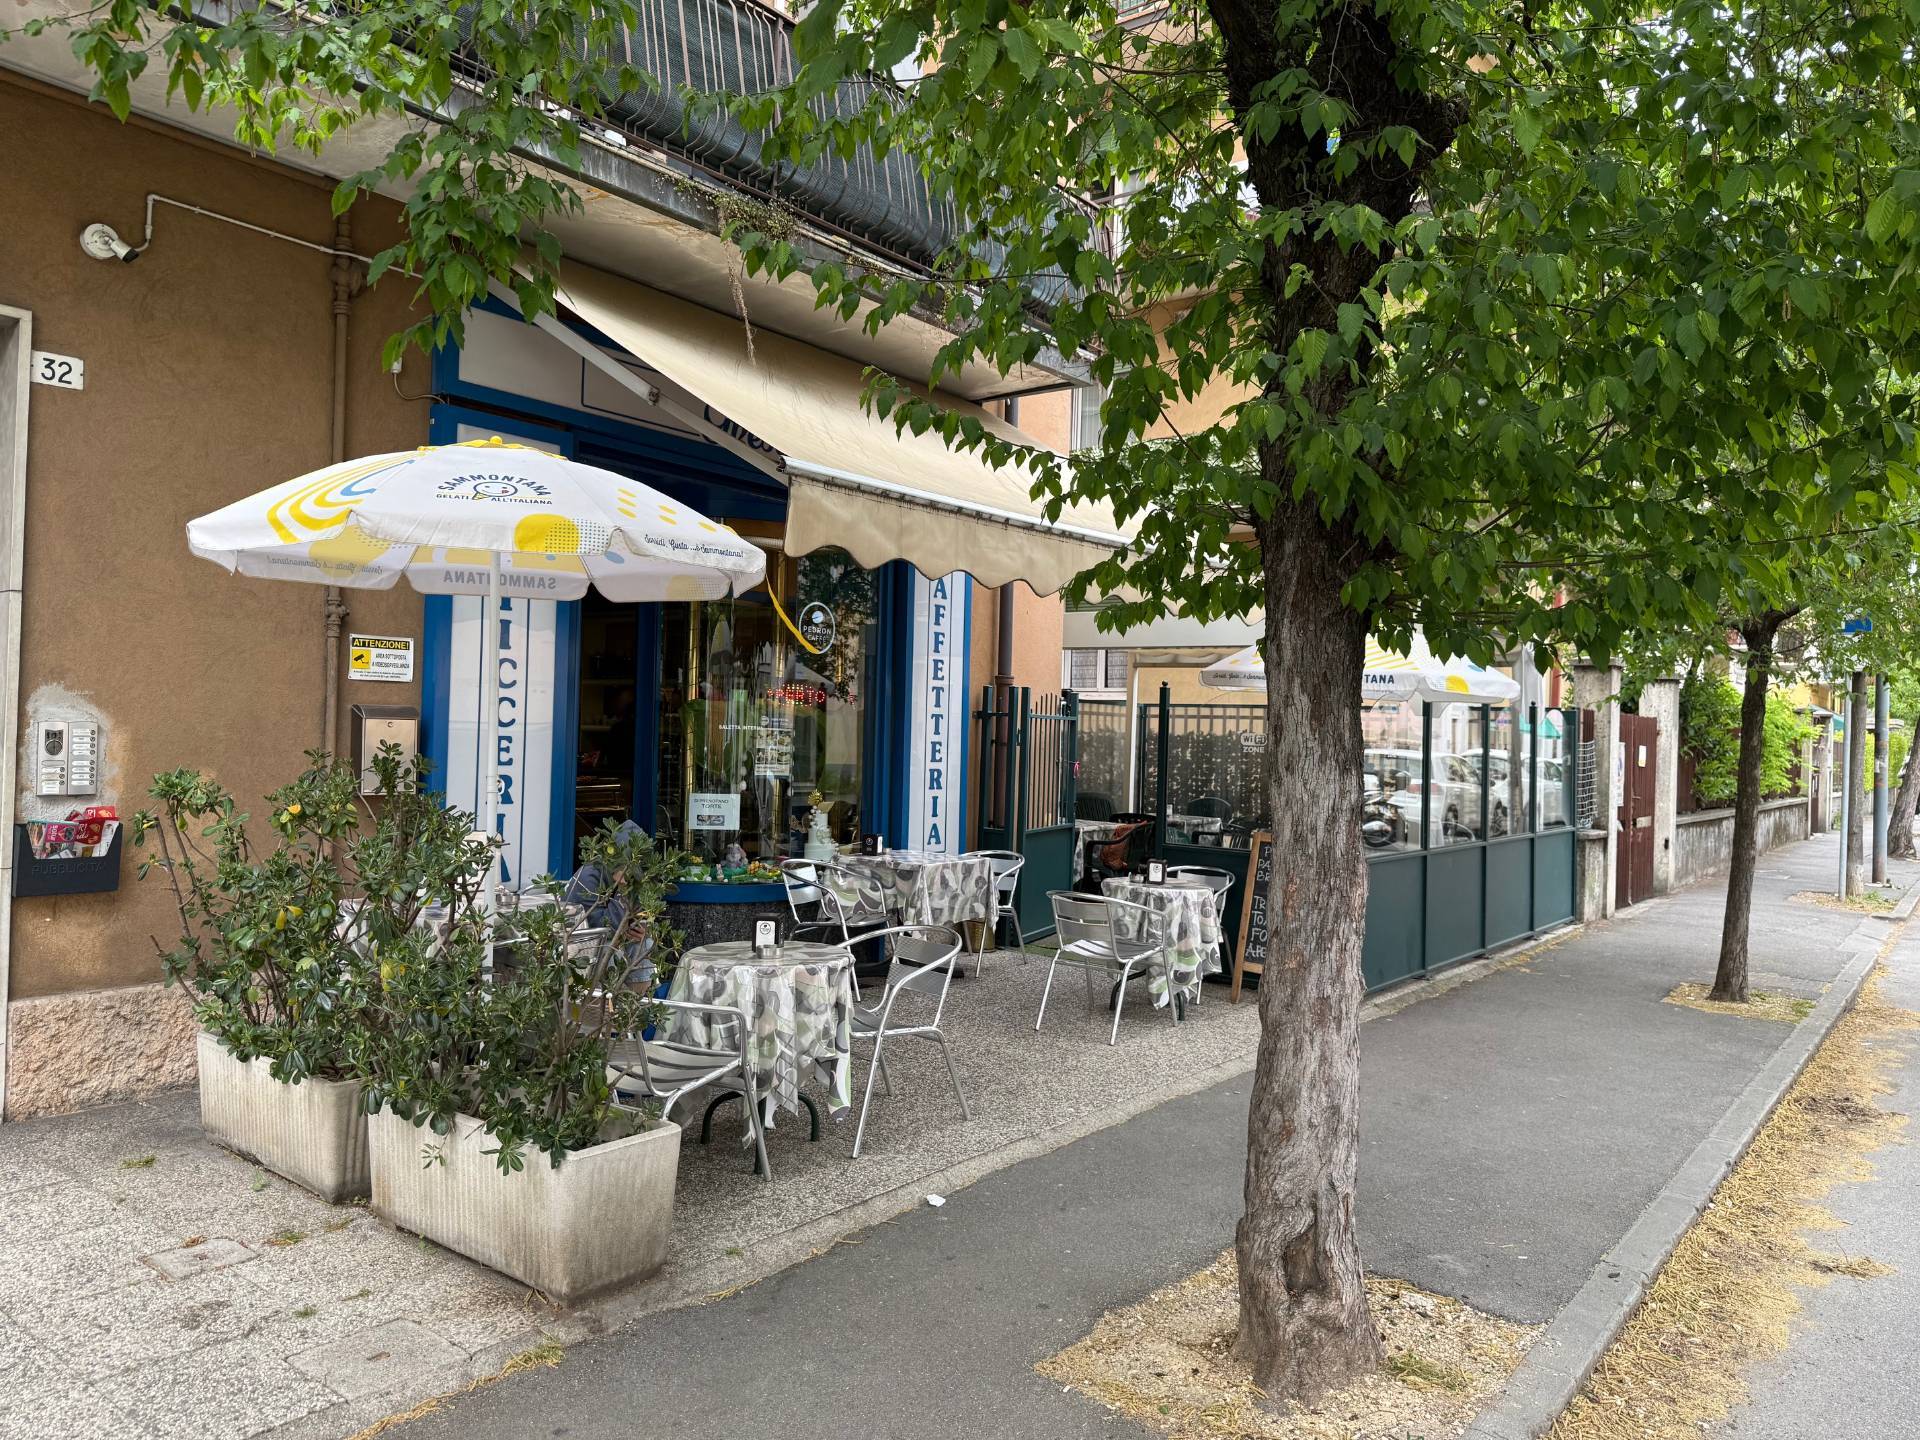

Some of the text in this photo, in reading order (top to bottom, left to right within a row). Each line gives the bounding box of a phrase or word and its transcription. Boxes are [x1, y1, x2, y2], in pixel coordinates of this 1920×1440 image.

[41, 357, 73, 385] 32
[438, 474, 552, 496] SAMMONTANA
[491, 497, 553, 505] ALL'ITALIANA
[353, 639, 409, 650] ATTENZIONE!
